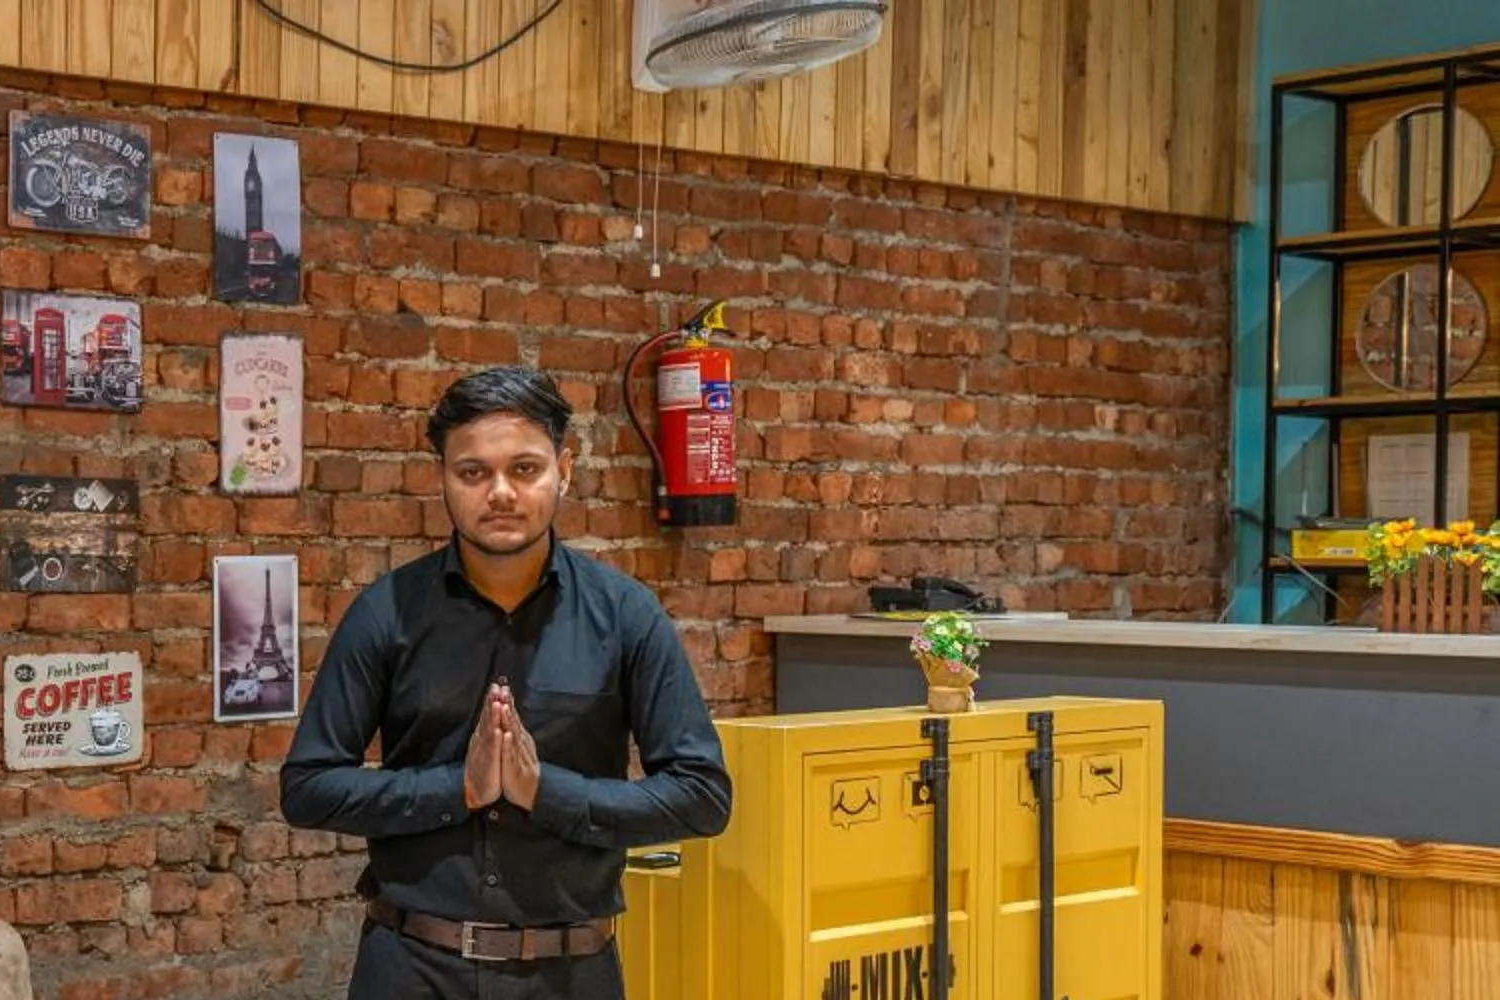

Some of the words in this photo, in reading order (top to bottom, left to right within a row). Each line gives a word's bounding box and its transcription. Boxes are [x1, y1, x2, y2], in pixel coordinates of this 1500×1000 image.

[20, 125, 80, 158] LEGENDS
[82, 126, 124, 153] NEVER
[121, 143, 145, 168] DIE
[15, 671, 134, 720] COFFEE
[22, 721, 71, 734] SERVED
[25, 734, 65, 747] HERE
